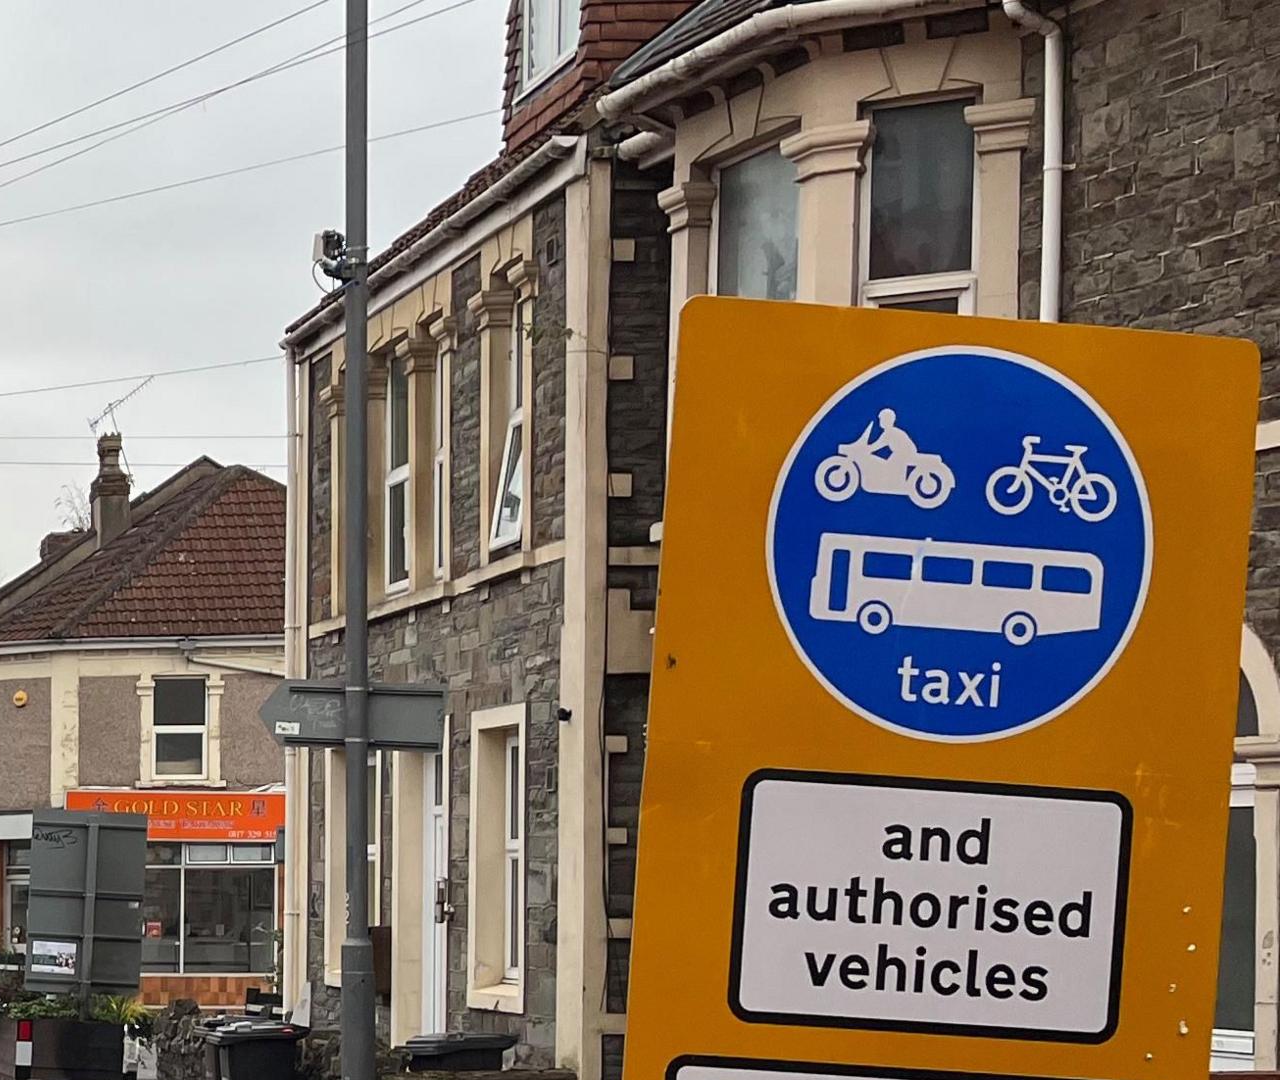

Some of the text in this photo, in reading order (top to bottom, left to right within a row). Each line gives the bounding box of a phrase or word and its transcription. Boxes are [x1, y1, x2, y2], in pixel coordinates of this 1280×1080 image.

[897, 655, 1002, 708] taxi
[114, 799, 243, 816] GOLD STAR
[882, 817, 992, 865] and
[768, 876, 1093, 938] authorised
[804, 943, 1049, 1002] vehicles
